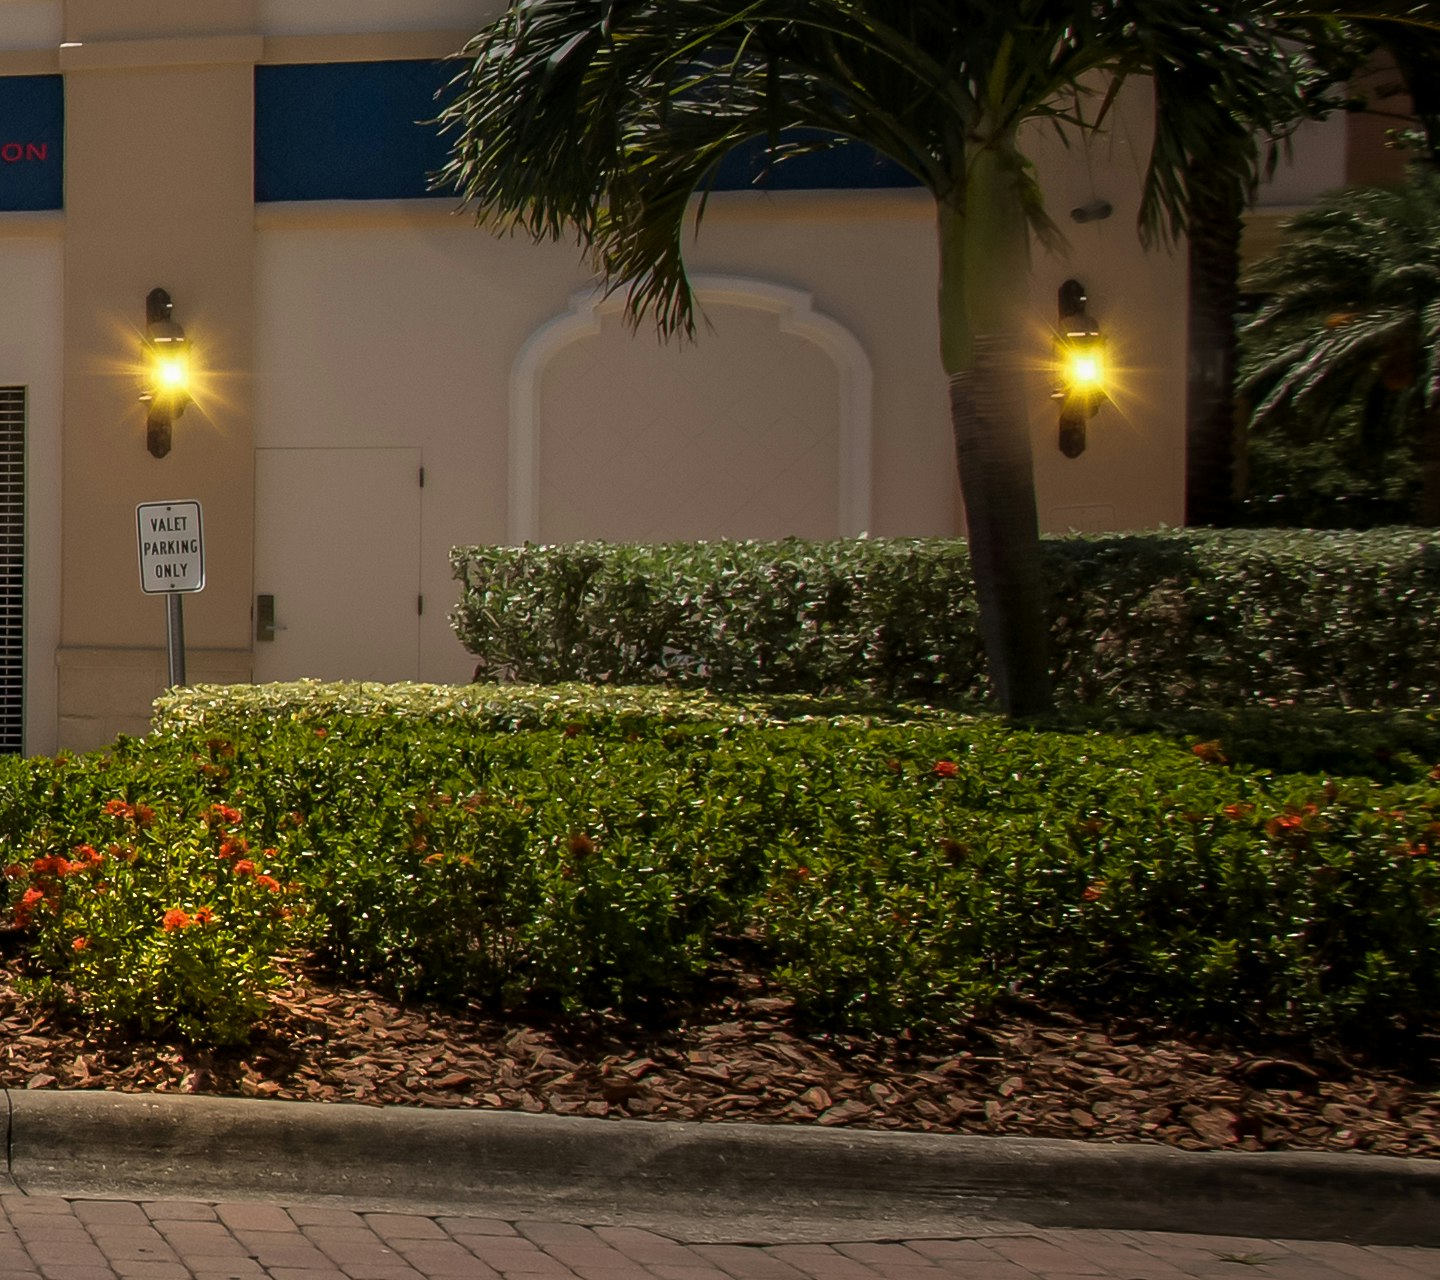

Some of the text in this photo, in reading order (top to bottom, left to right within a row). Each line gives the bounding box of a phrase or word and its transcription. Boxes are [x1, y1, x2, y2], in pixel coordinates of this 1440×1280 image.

[151, 517, 187, 532] VALET
[144, 539, 198, 556] PARKING
[155, 563, 188, 578] ONLY
